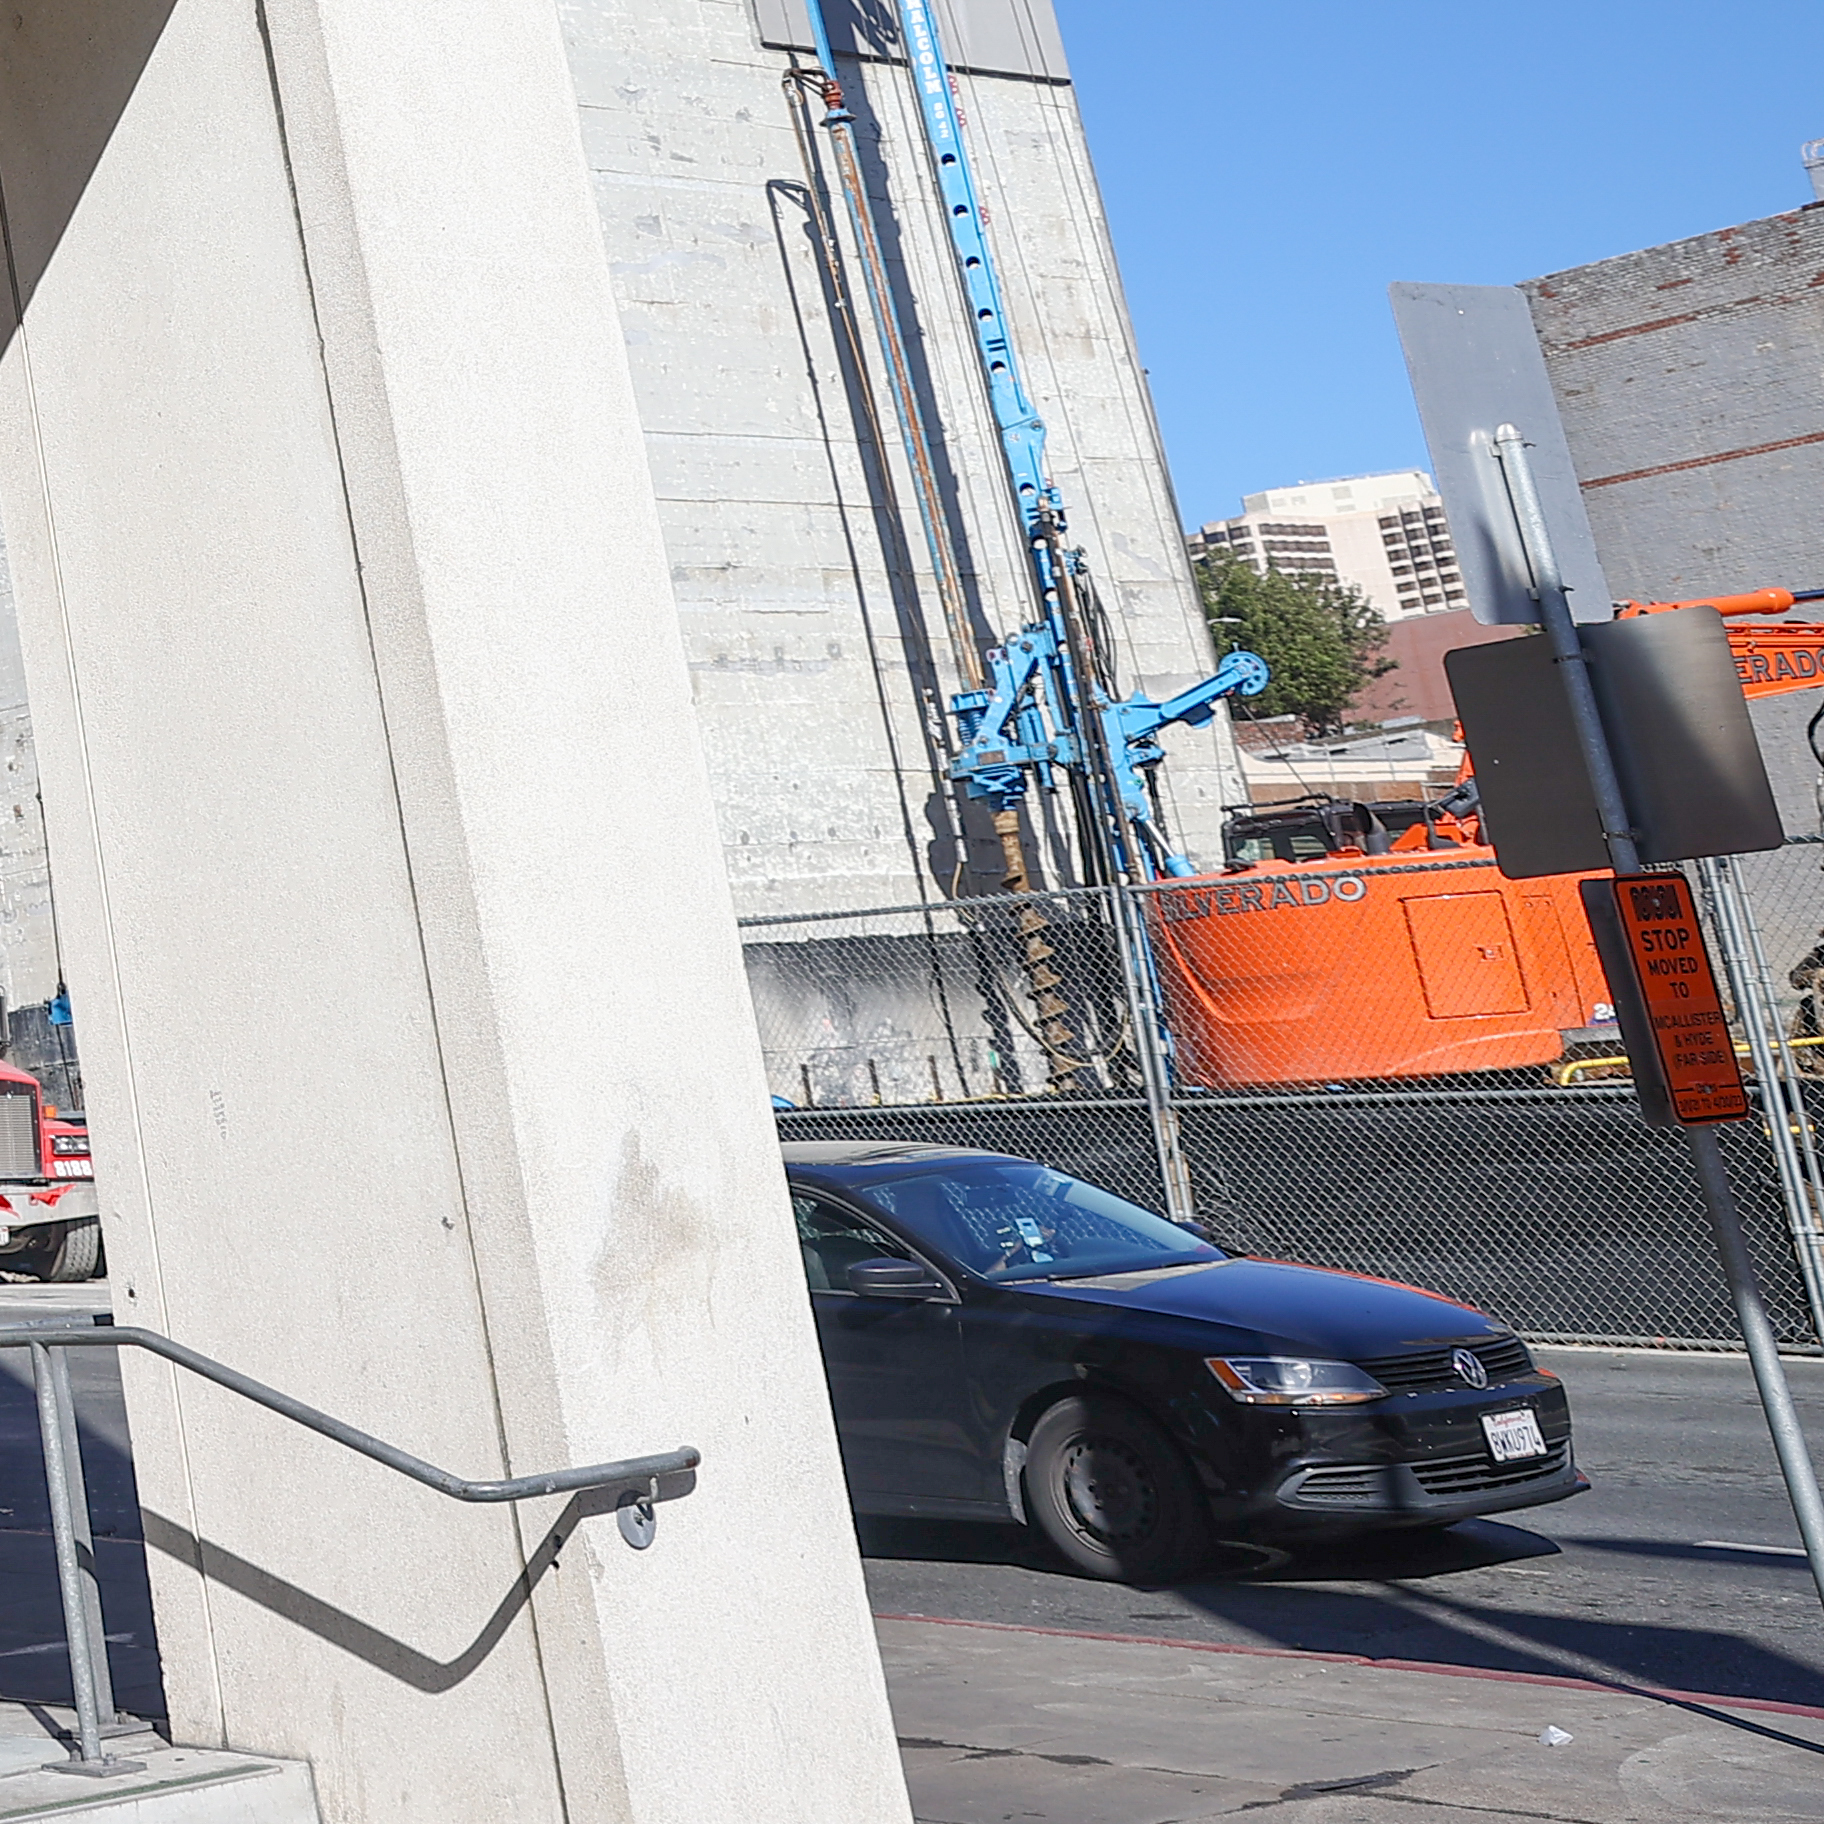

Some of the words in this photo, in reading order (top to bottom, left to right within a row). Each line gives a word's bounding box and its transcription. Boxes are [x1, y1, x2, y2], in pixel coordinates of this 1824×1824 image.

[1640, 929, 1690, 952] STOP
[1647, 957, 1698, 975] MOVED
[1669, 982, 1690, 998] TO
[1685, 1032, 1713, 1046] HYDE
[53, 1160, 92, 1177] 8188
